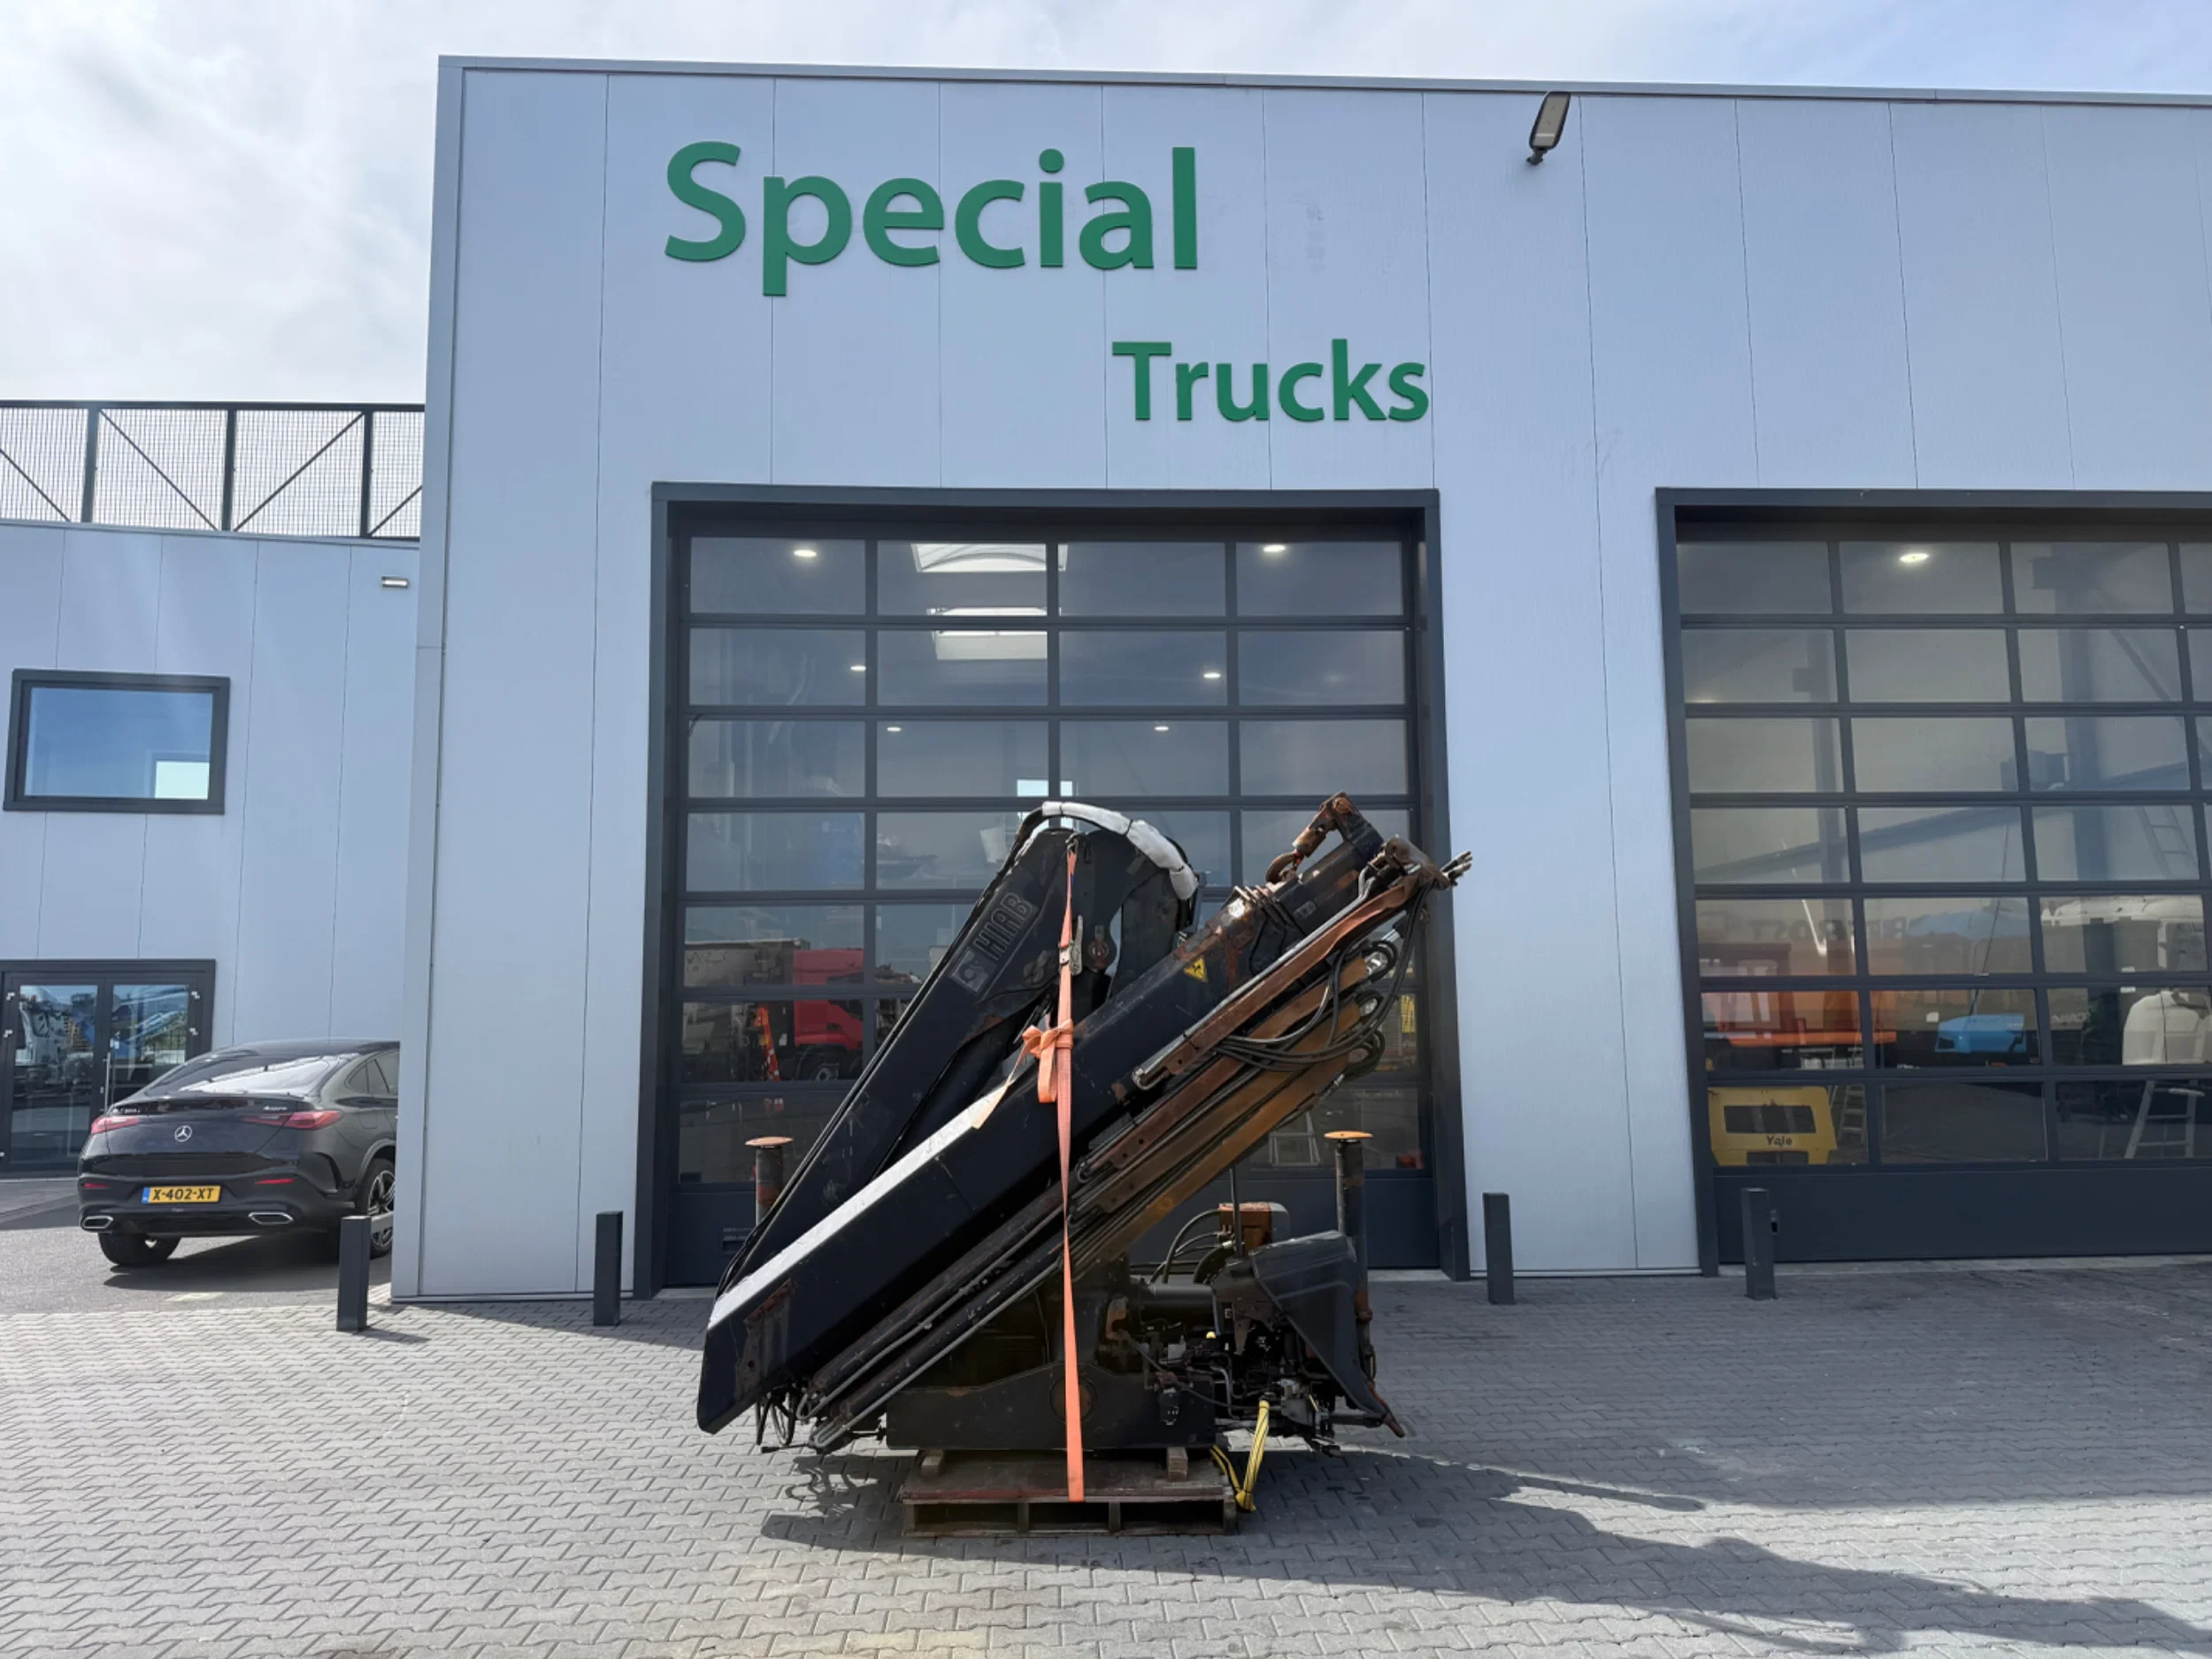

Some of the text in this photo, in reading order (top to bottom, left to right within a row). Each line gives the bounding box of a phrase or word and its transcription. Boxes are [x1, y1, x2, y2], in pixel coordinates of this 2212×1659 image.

[665, 142, 1197, 296] Special
[1112, 338, 1429, 422] Trucks
[973, 892, 1033, 961] HIAB
[1766, 1134, 1793, 1148] Yale
[152, 1187, 214, 1202] X-402-XT
